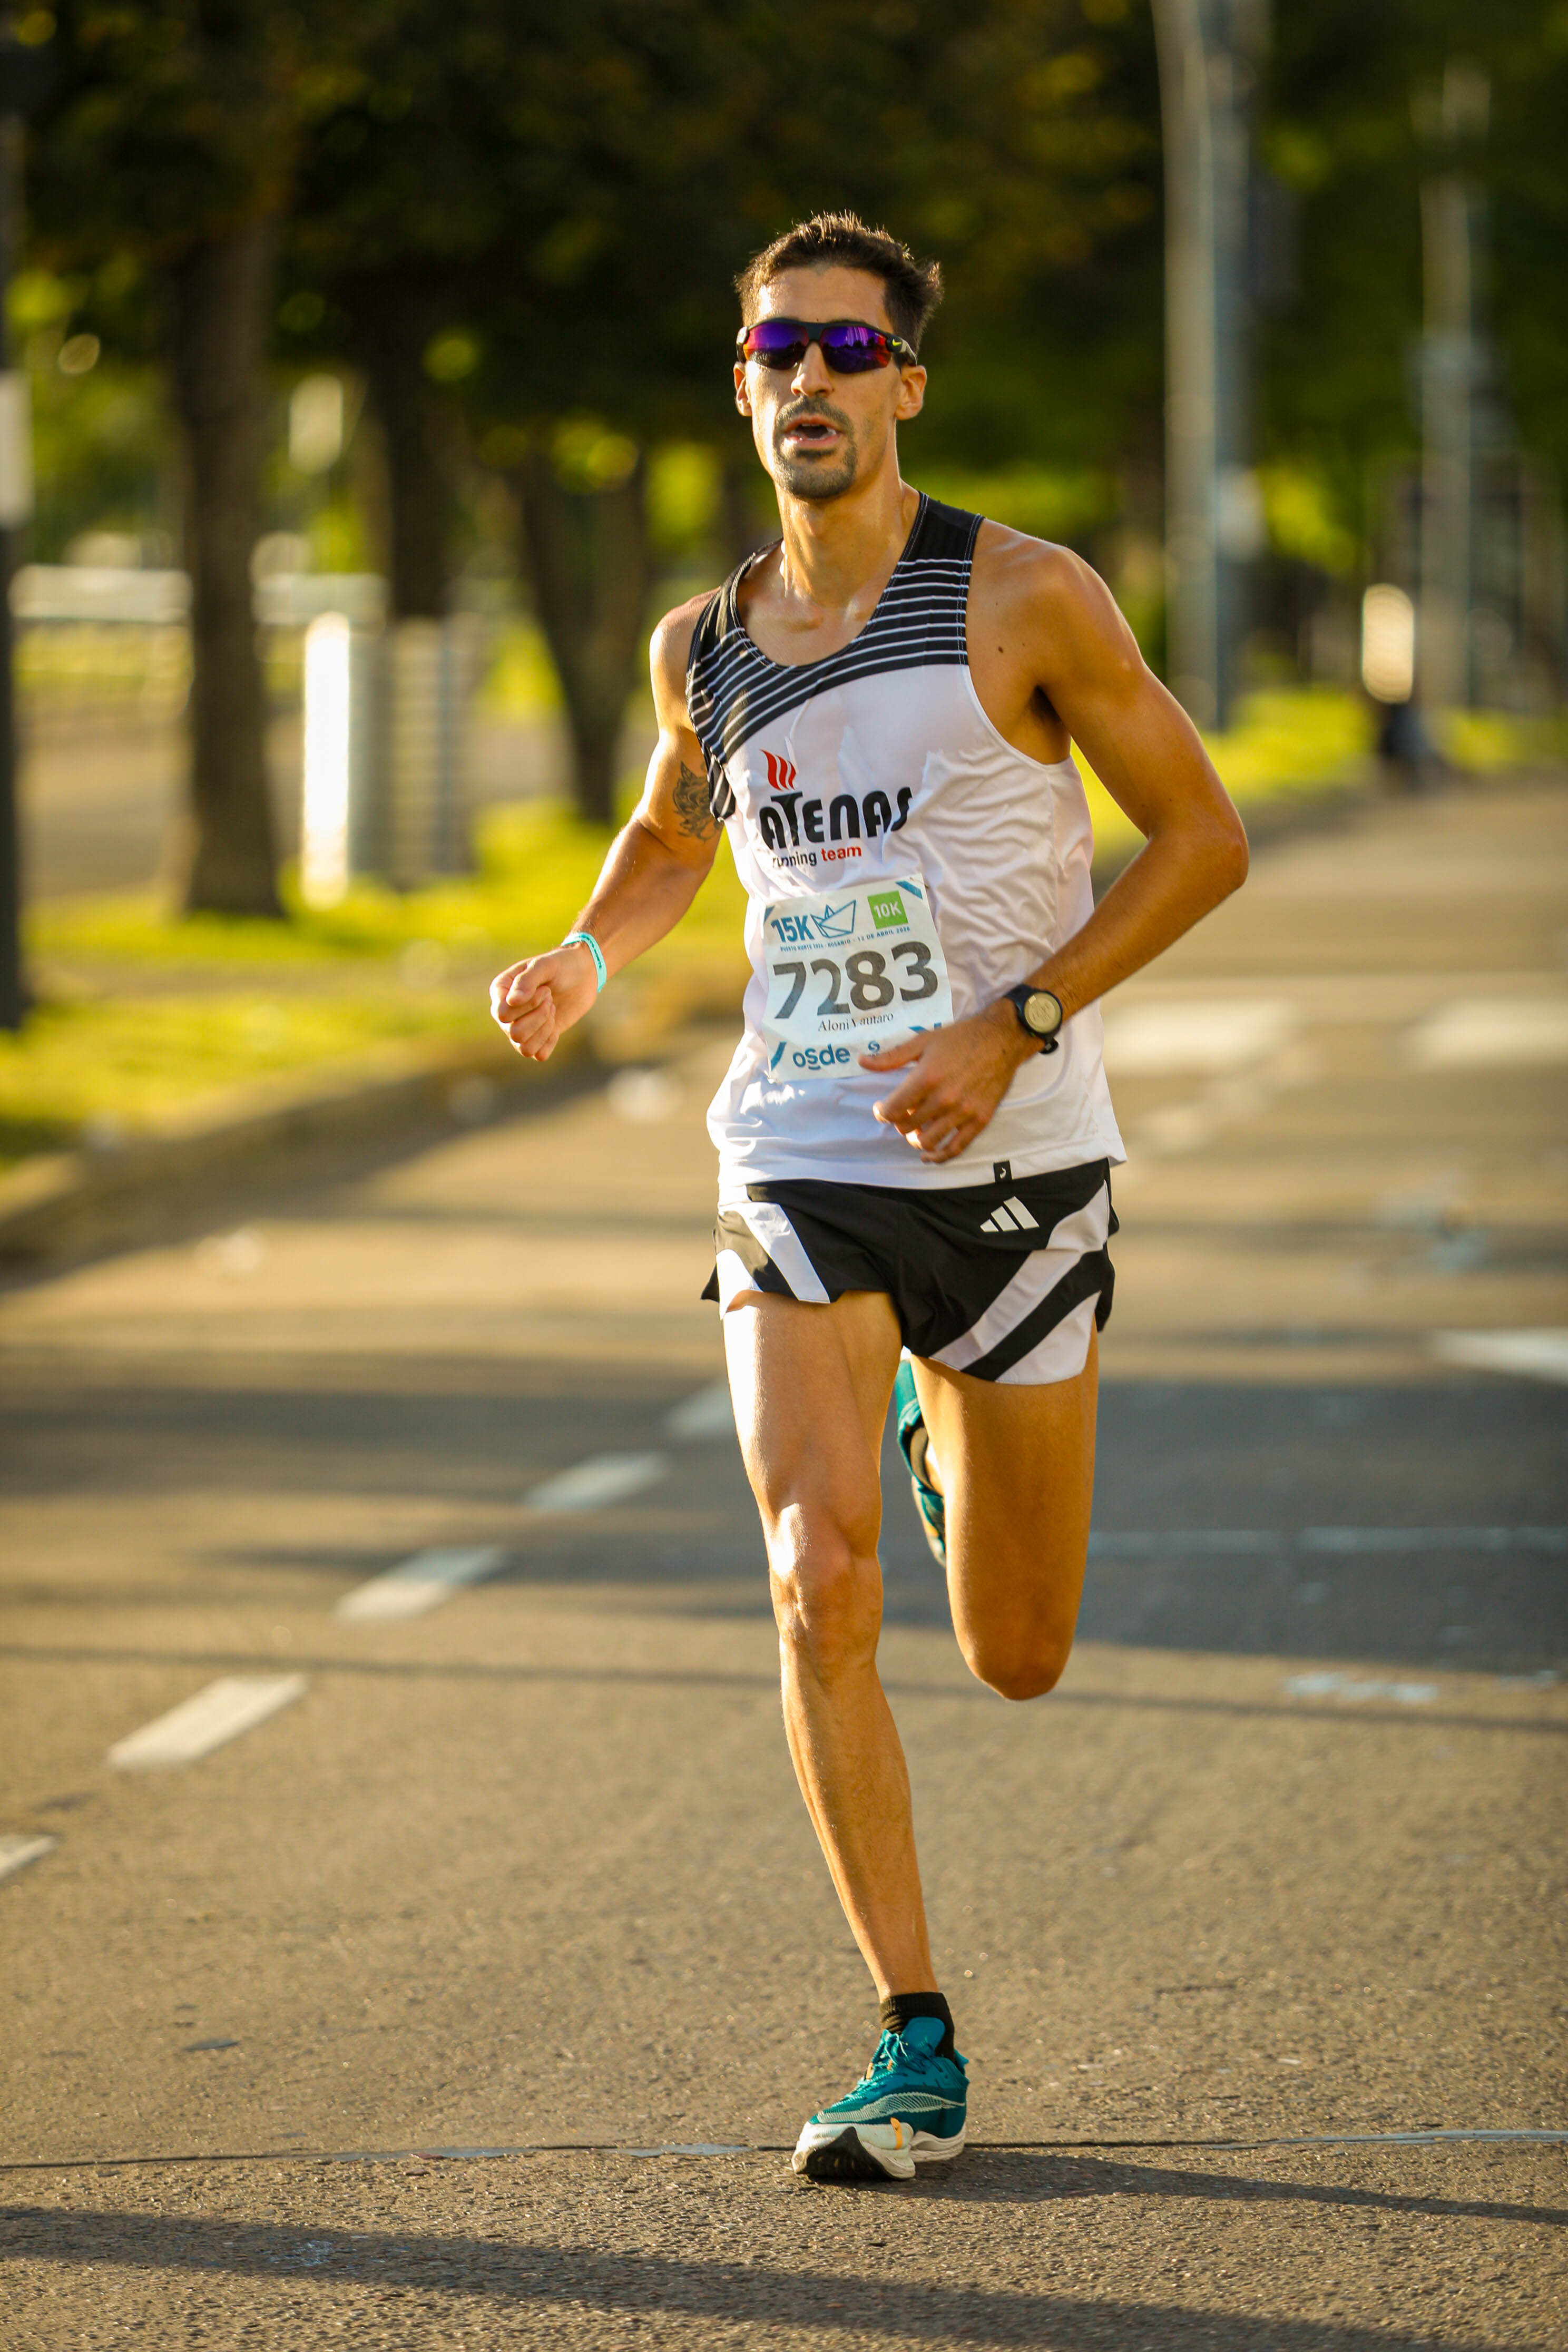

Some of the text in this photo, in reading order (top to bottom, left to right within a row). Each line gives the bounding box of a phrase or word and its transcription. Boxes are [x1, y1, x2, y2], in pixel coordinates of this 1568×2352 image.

[772, 846, 863, 868] running team
[874, 901, 903, 919] 10K
[771, 915, 815, 943] 15K
[877, 929, 894, 938] ABRIL
[773, 941, 938, 1019] 7283
[818, 1017, 849, 1032] Aloni
[792, 1044, 851, 1070] osde
